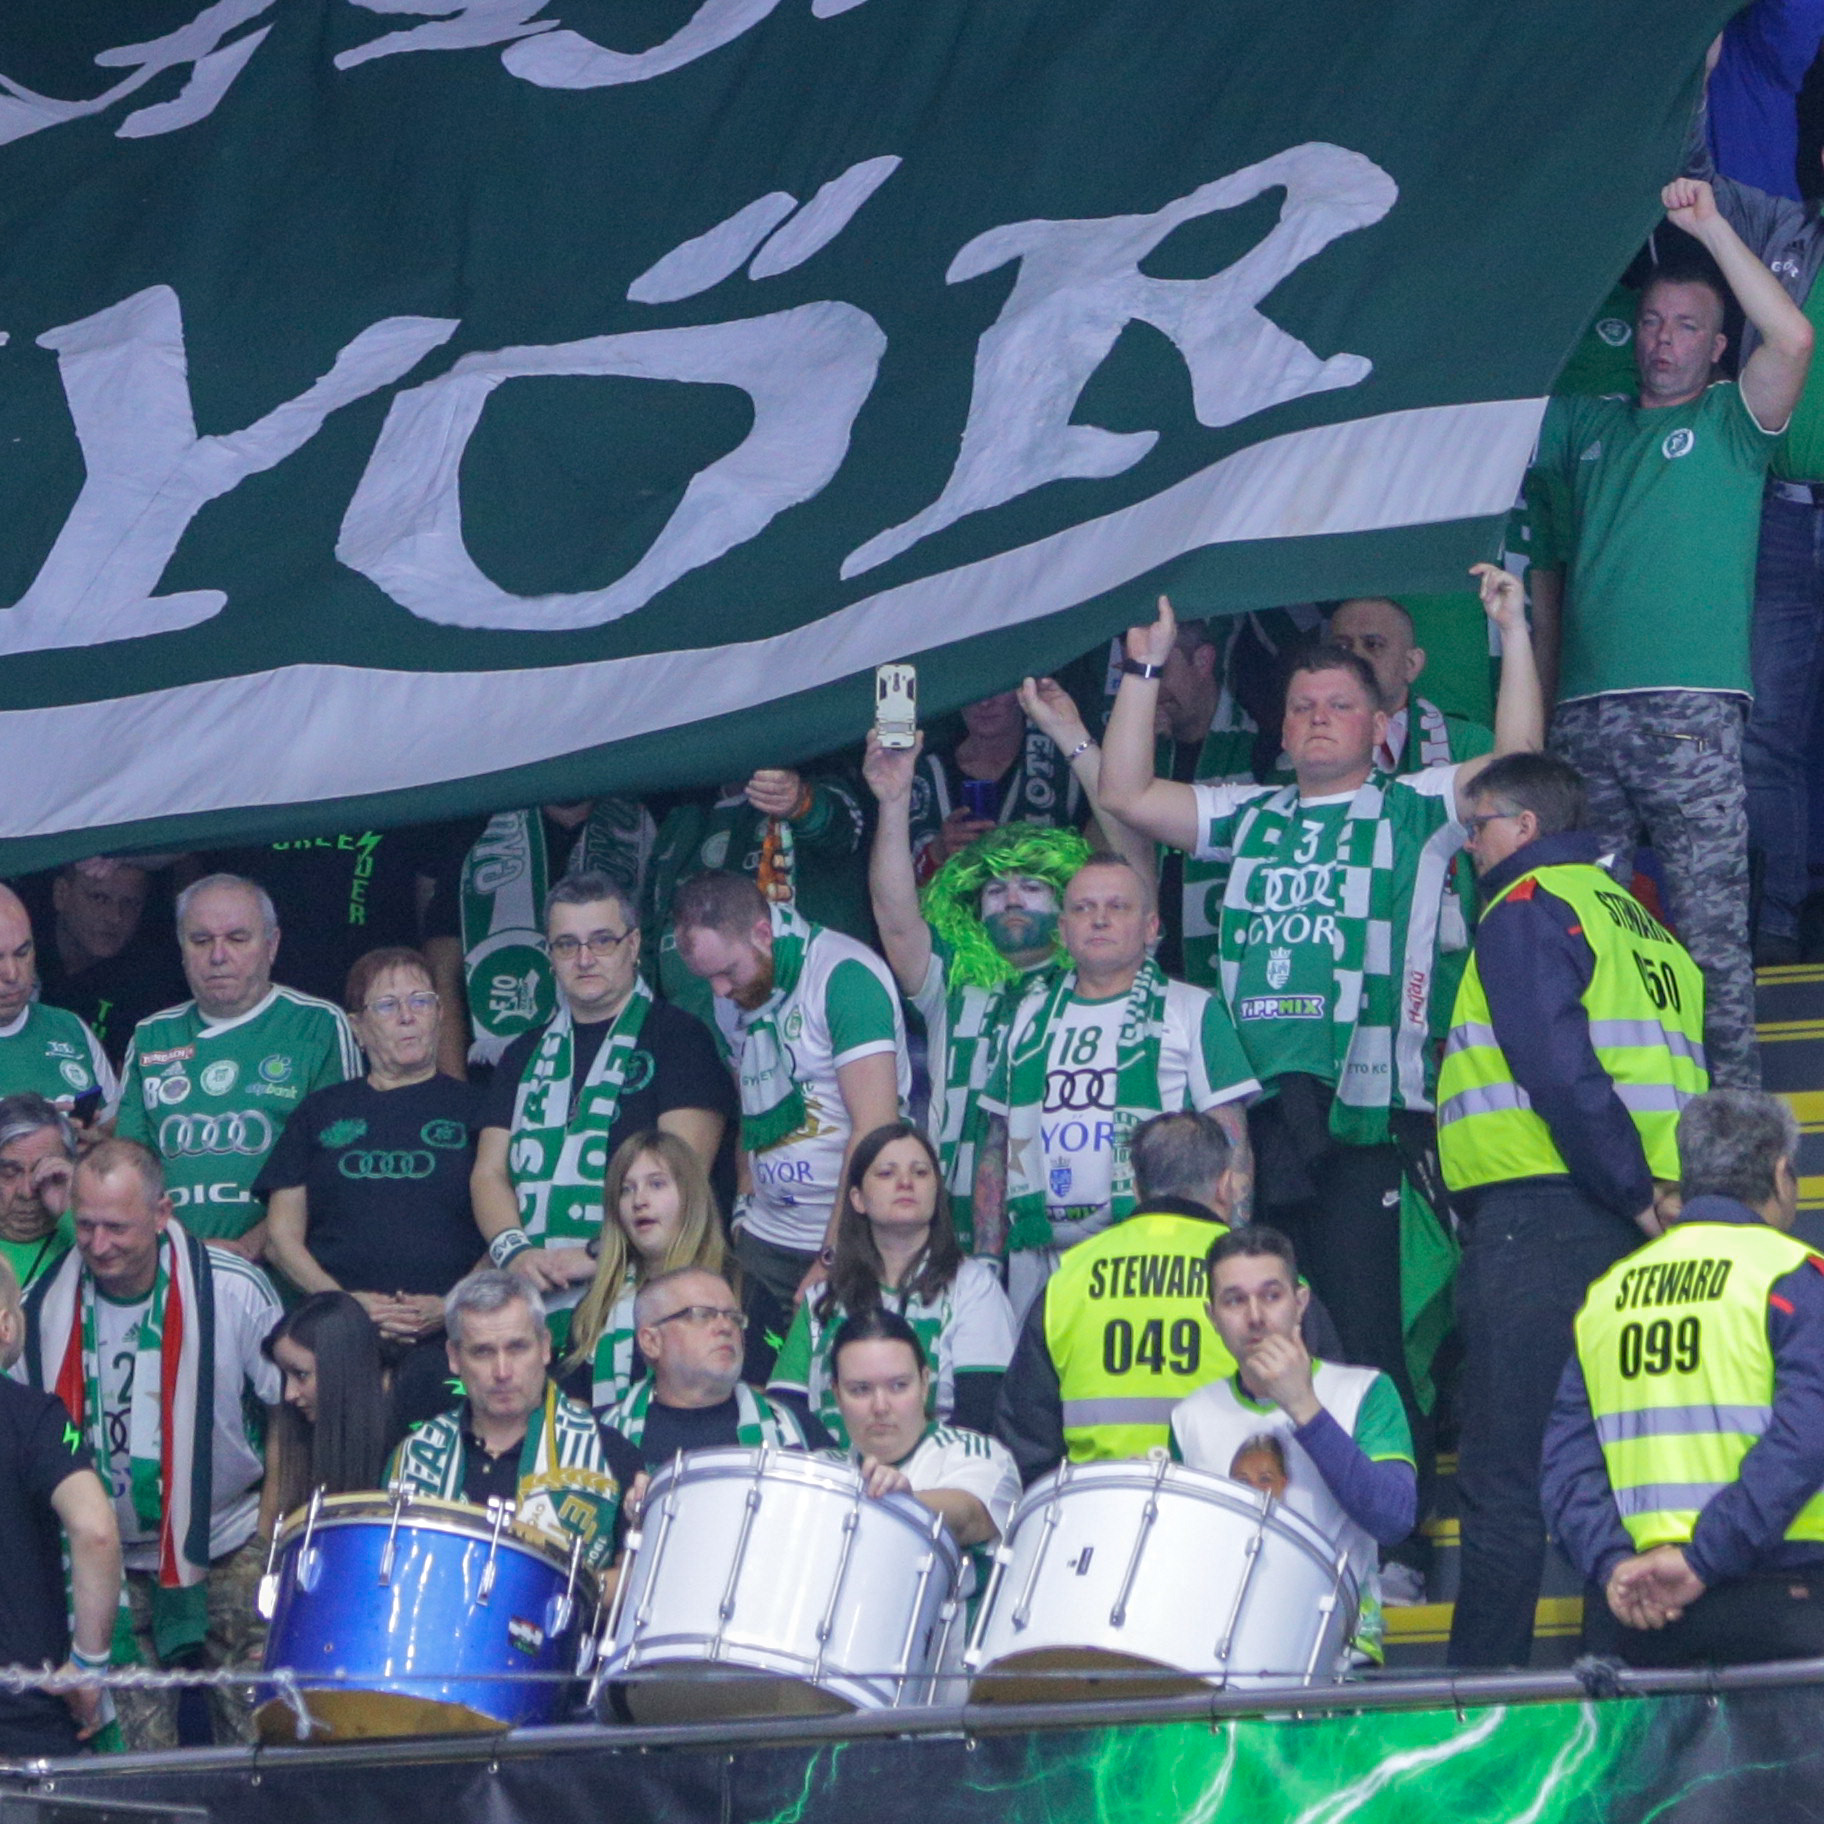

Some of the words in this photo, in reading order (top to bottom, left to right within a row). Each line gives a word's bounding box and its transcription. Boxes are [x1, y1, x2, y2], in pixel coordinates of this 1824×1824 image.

[1293, 821, 1324, 864] 3
[1057, 1026, 1103, 1066] 18
[1041, 1116, 1115, 1154] YŐR
[1614, 1259, 1733, 1312] STEWARD
[1102, 1318, 1202, 1377] 049
[1619, 1316, 1702, 1381] 099
